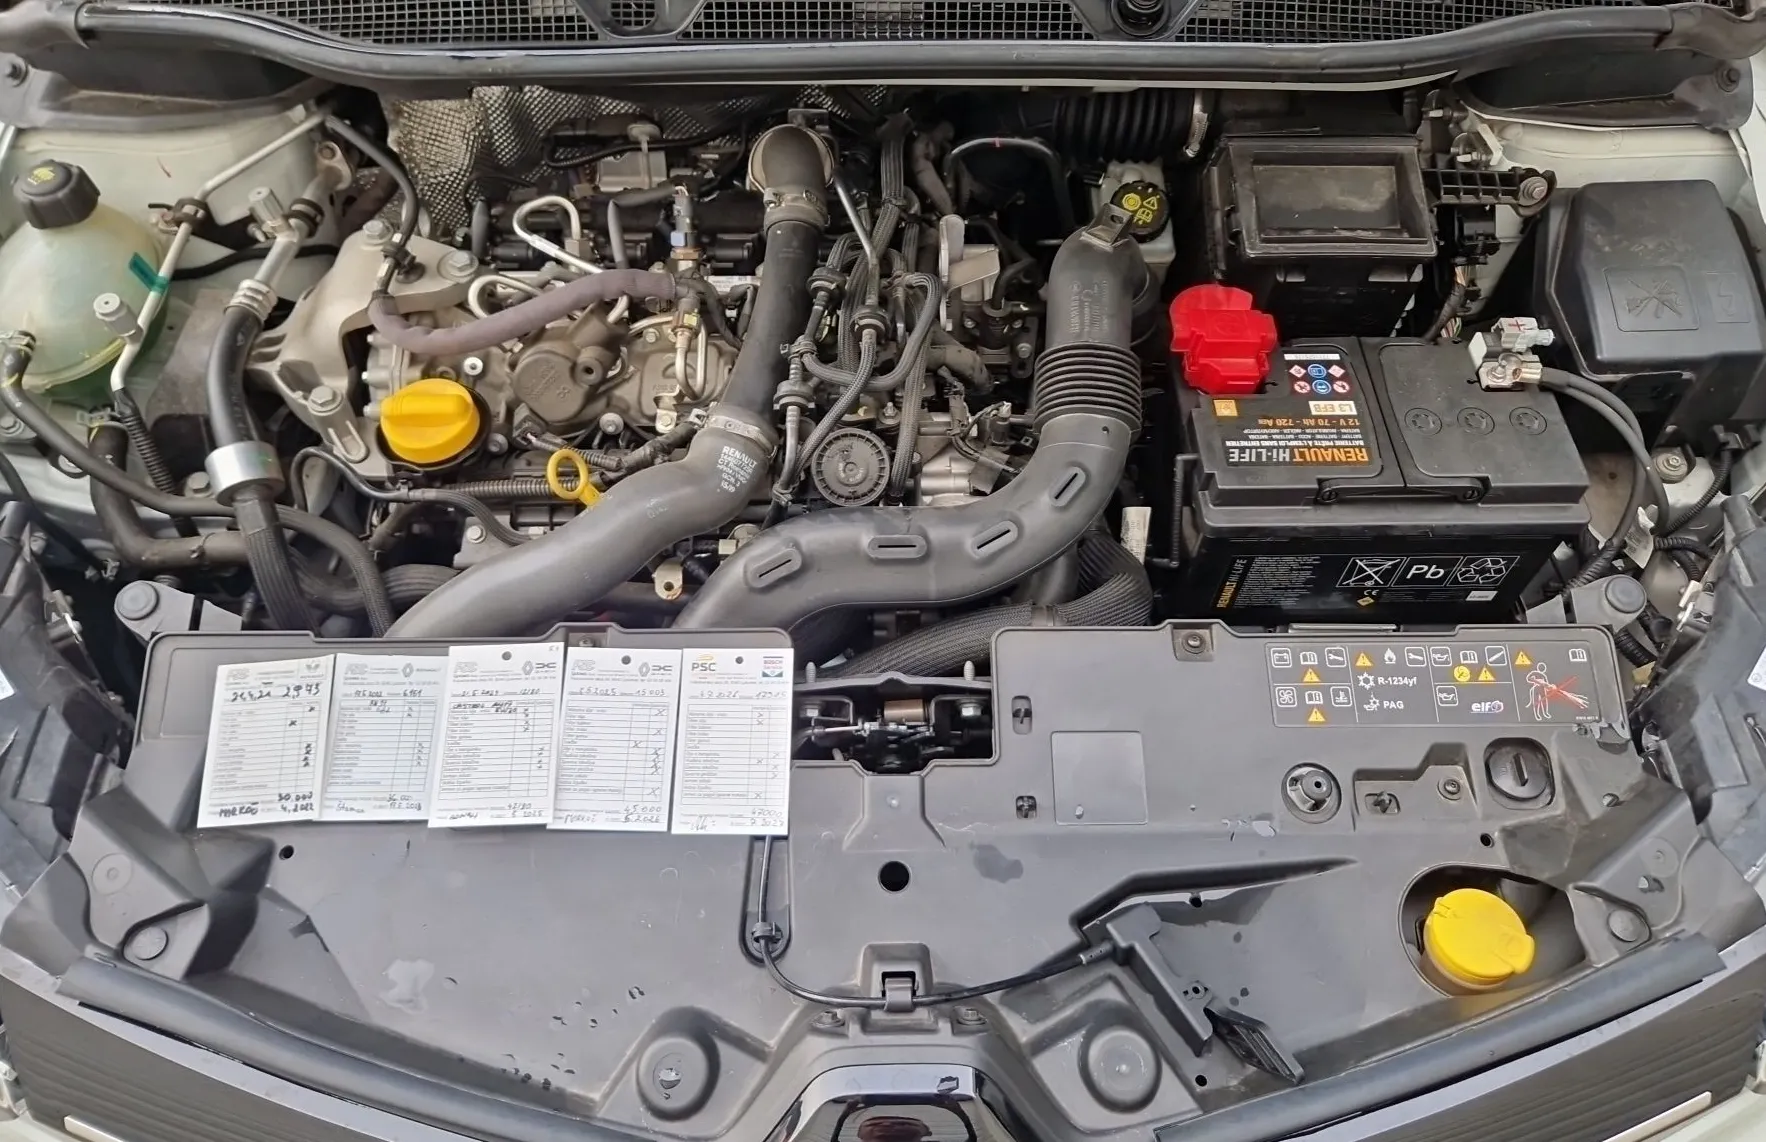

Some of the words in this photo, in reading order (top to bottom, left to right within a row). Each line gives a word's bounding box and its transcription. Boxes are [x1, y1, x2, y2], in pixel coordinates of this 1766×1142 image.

[1313, 404, 1336, 412] EFB
[1338, 404, 1352, 412] L3
[722, 446, 757, 468] RENAULT
[1228, 448, 1290, 462] Hi-LIFE
[1292, 447, 1368, 462] RENAULT
[1406, 564, 1445, 580] Pb
[1216, 581, 1237, 608] RENAULT
[691, 662, 716, 672] PSC
[1377, 676, 1418, 687] R-1234yf
[1383, 700, 1404, 710] PAG
